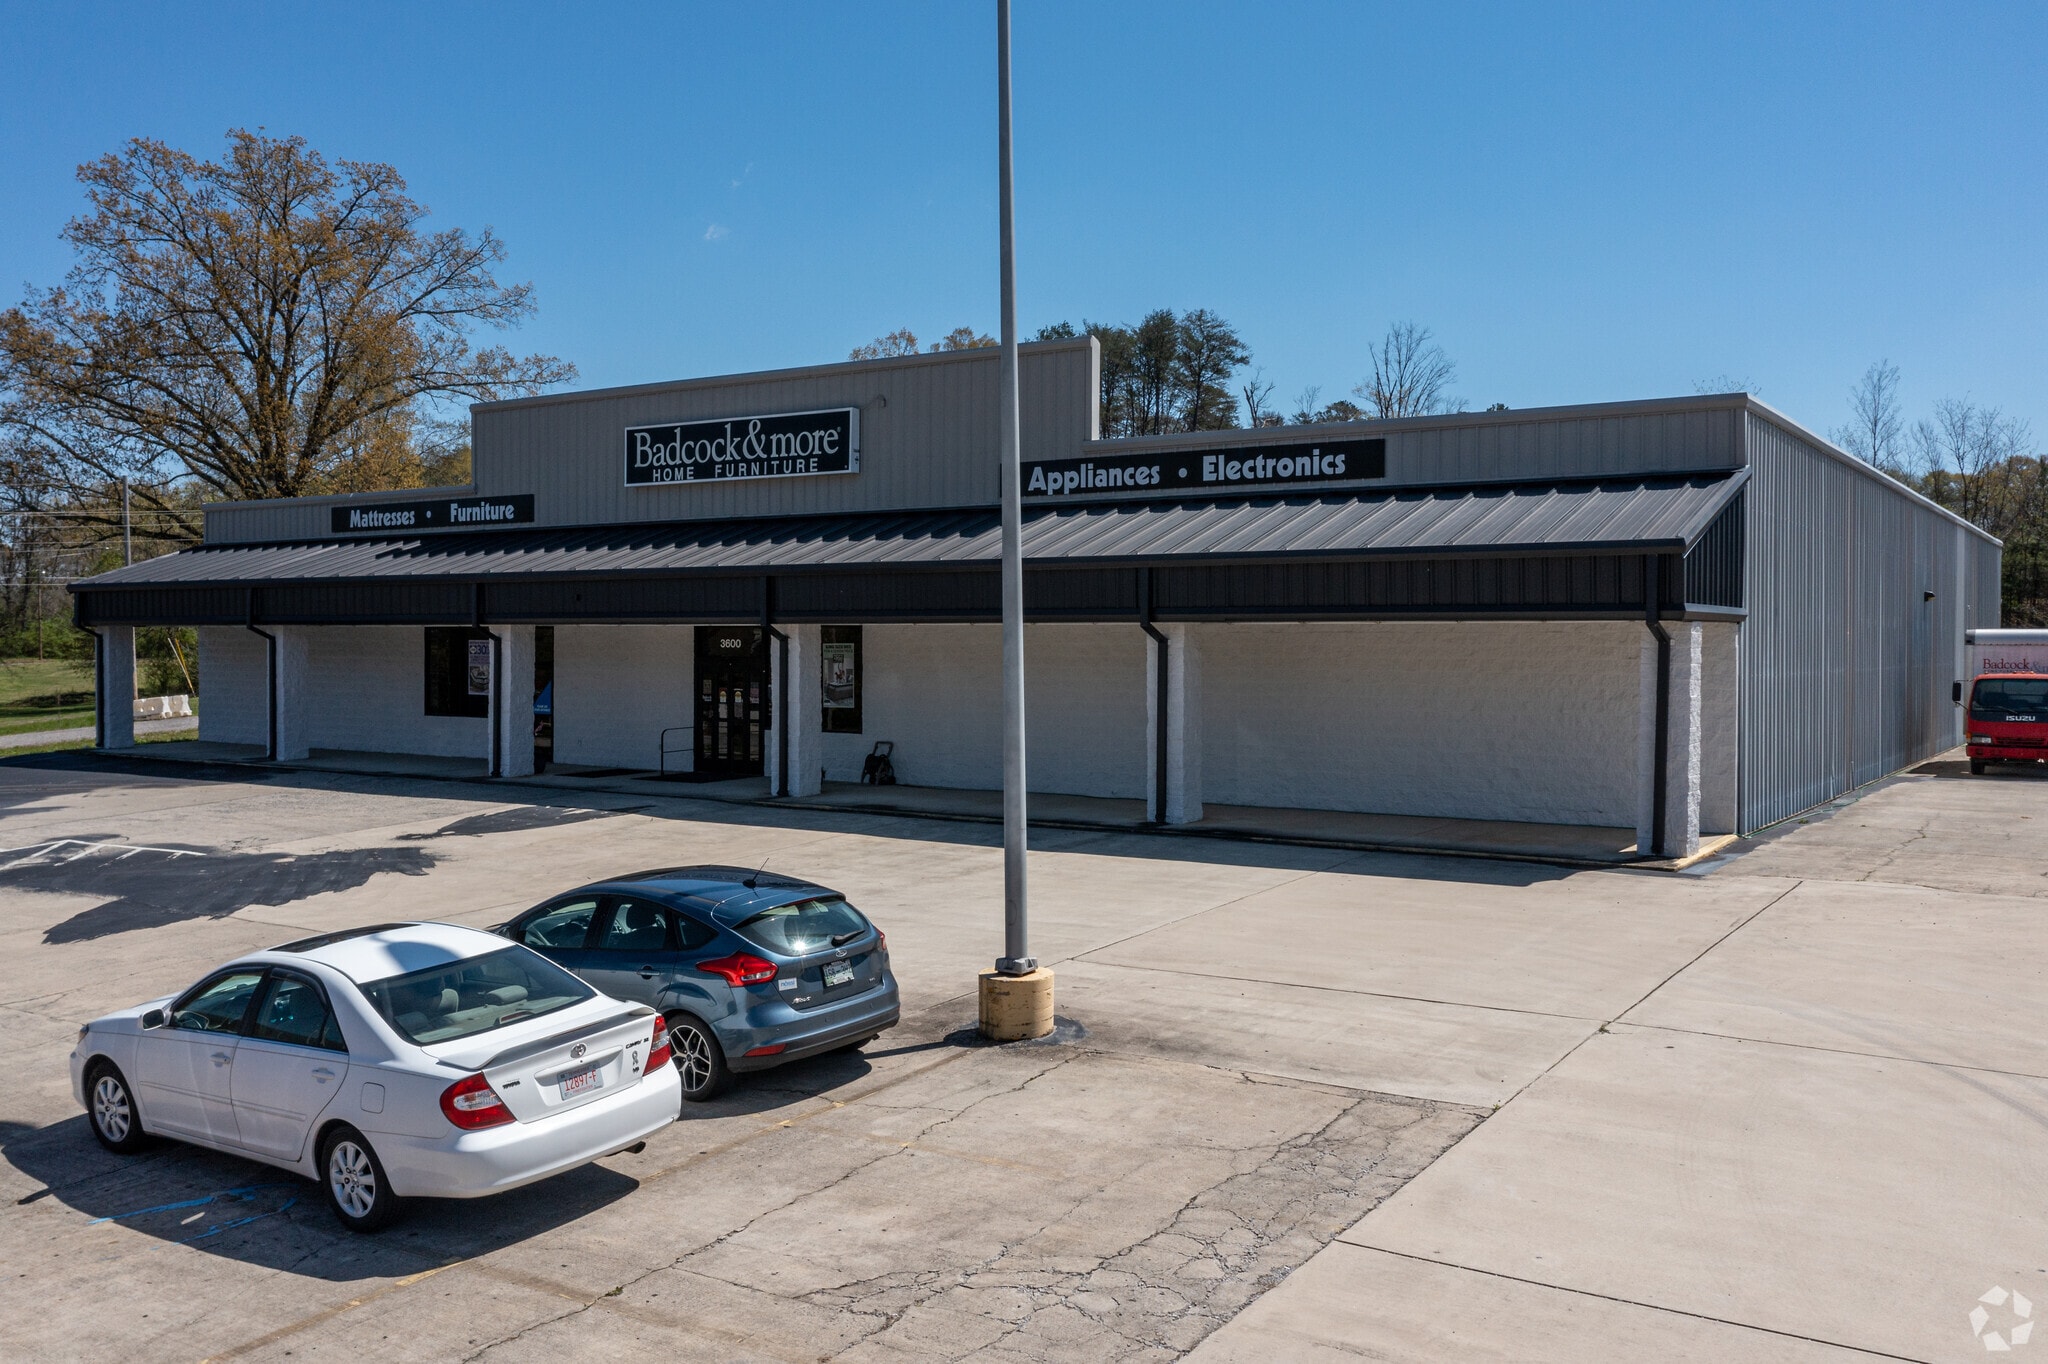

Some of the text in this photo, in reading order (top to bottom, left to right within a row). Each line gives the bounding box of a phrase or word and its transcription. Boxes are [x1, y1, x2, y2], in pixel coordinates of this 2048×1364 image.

[652, 458, 819, 482] HOME FURNITURE
[1027, 448, 1346, 496] Appliances Electronics
[349, 502, 515, 528] Mattresses Furniture
[720, 638, 742, 649] 3600
[564, 1069, 597, 1092] 12897-F
